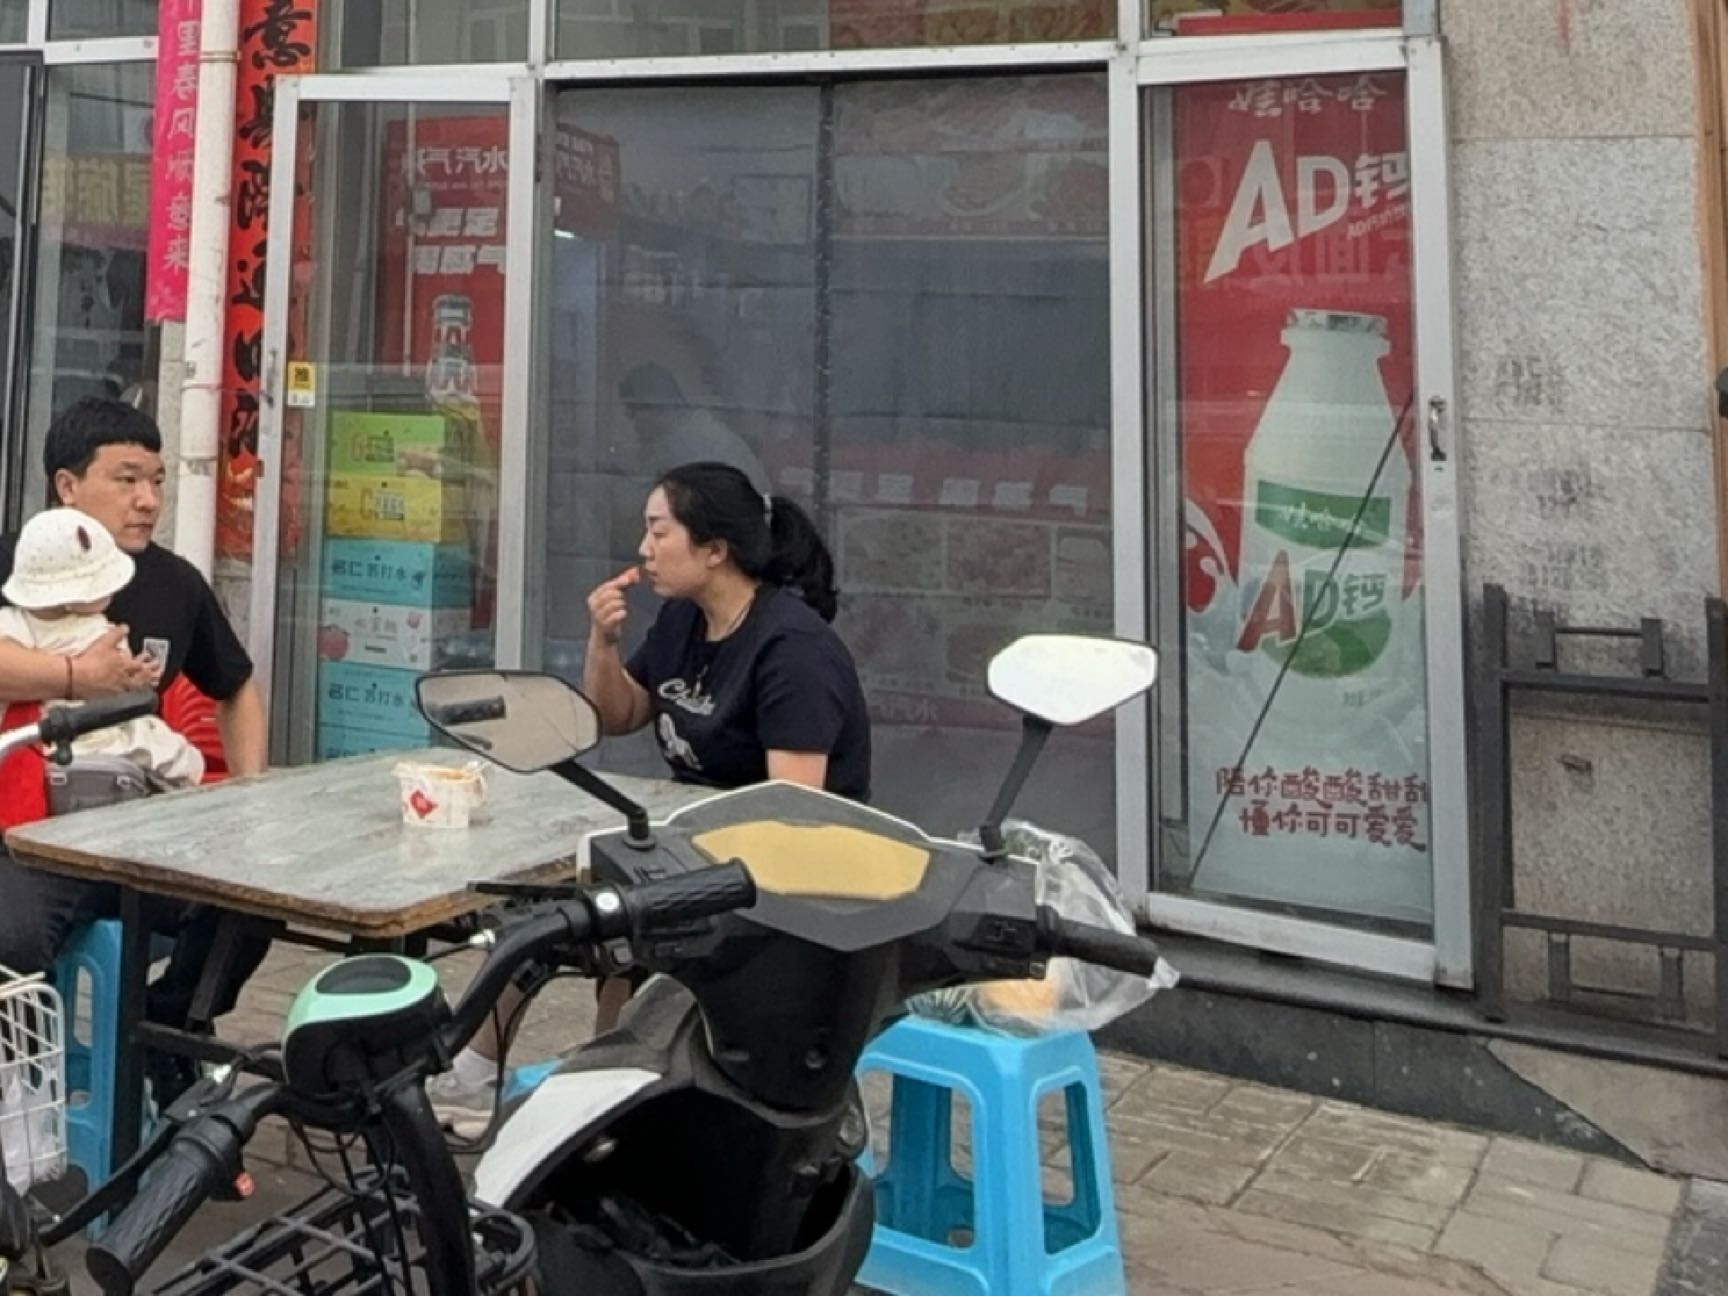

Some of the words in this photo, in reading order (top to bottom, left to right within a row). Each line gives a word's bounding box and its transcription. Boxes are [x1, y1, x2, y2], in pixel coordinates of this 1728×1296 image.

[1228, 78, 1388, 117] 娃哈哈
[1239, 799, 1428, 852] 懂你可可爱爱
